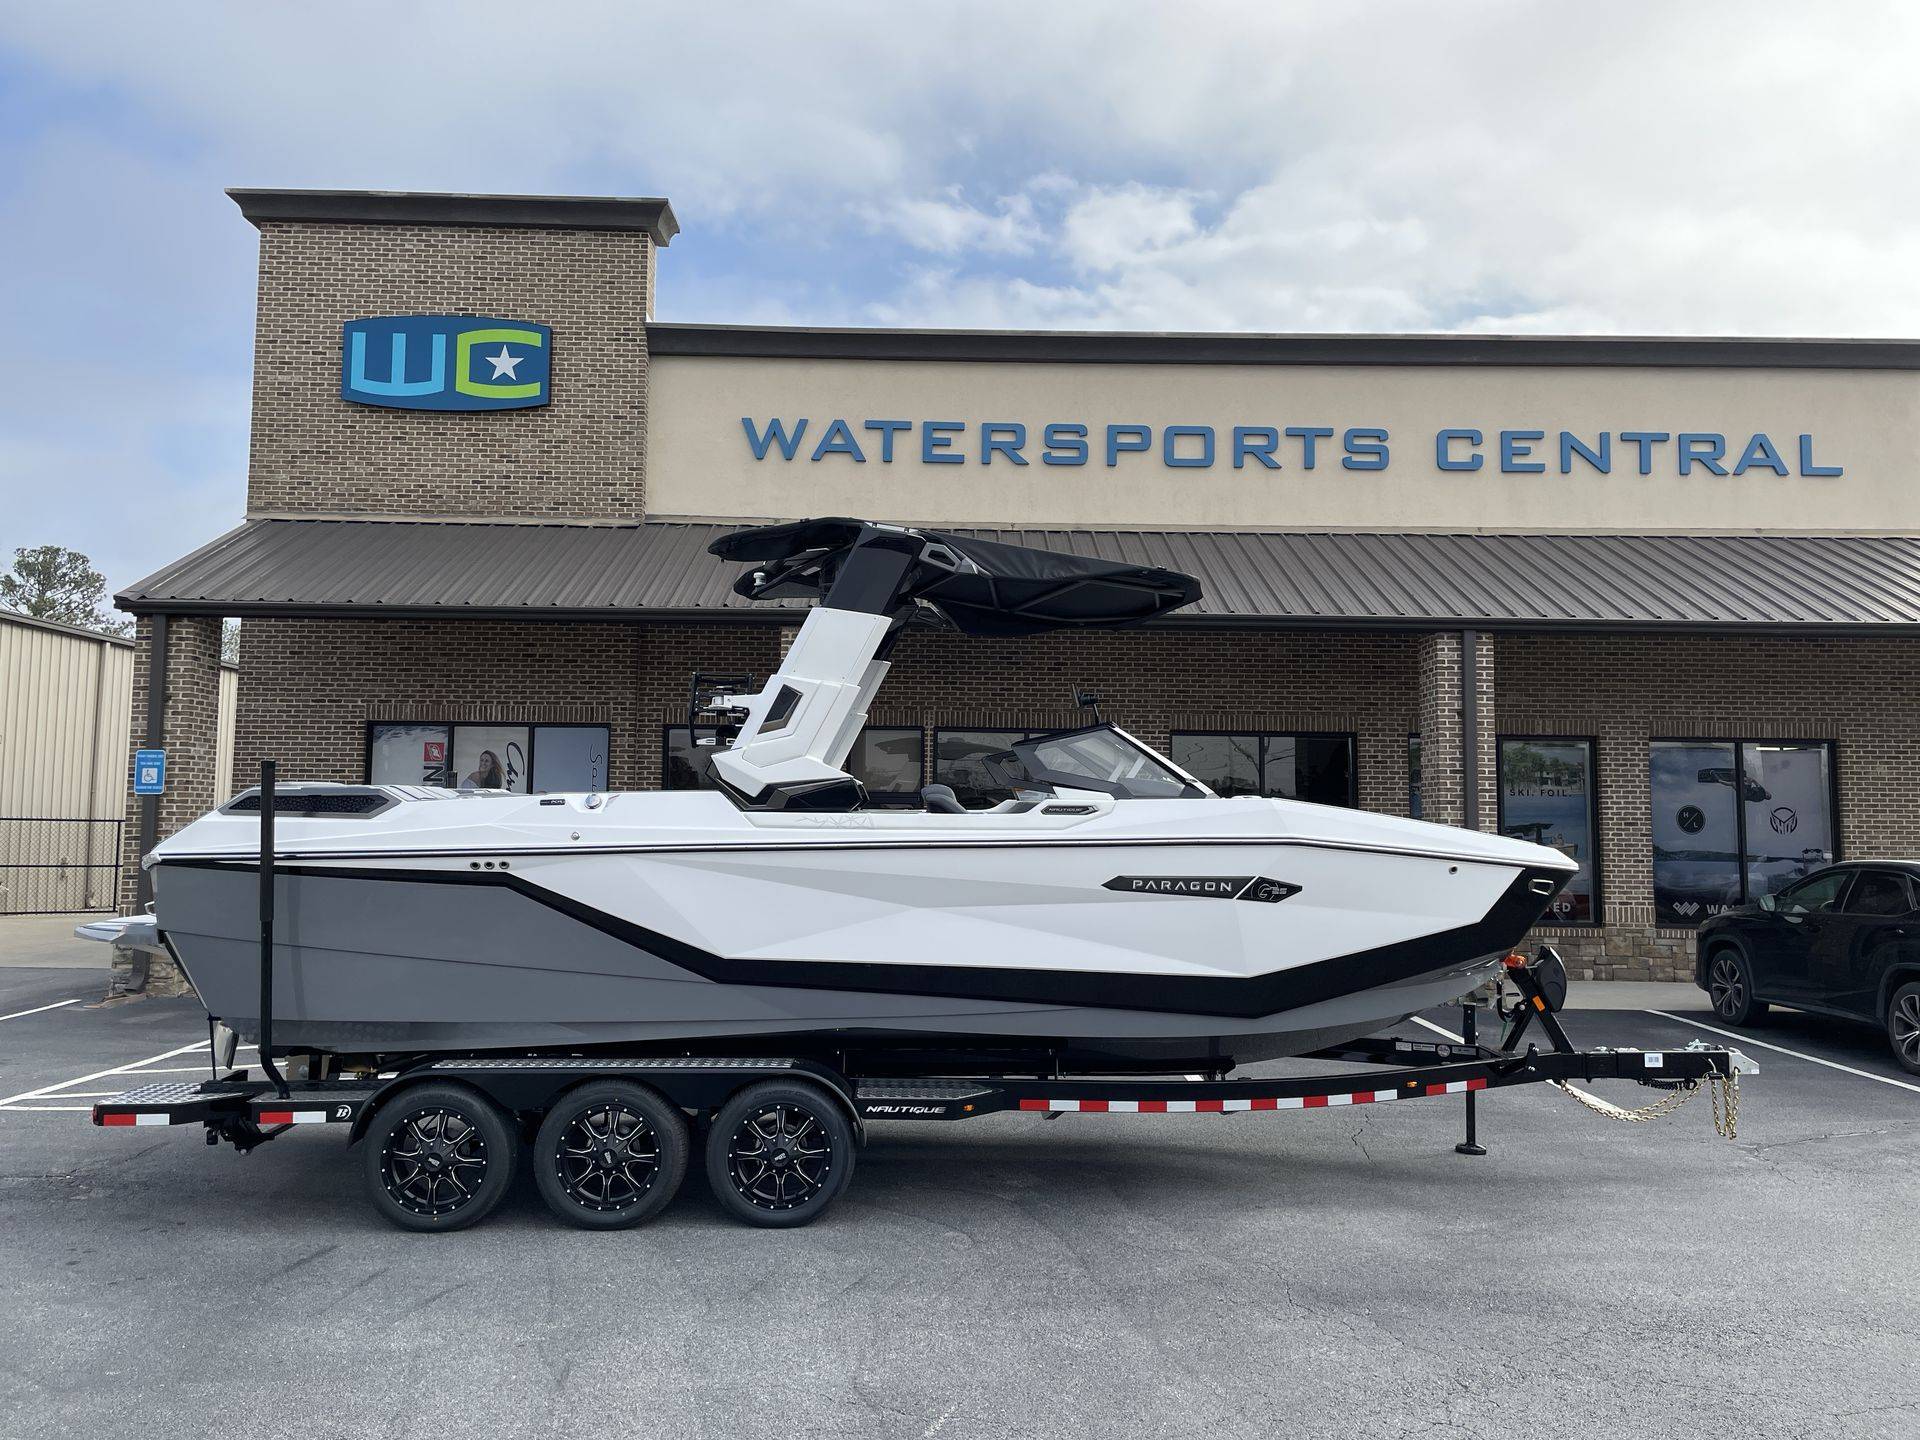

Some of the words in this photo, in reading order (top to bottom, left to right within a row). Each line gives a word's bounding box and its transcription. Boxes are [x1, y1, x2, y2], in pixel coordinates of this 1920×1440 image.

[741, 417, 1390, 471] WATERSPORTS
[1436, 429, 1844, 476] CENTRAL
[1509, 789, 1535, 797] SKI.
[1540, 788, 1572, 797] FOIL.
[1132, 879, 1233, 892] PARAGON
[865, 1105, 947, 1114] NAUTIQUE
